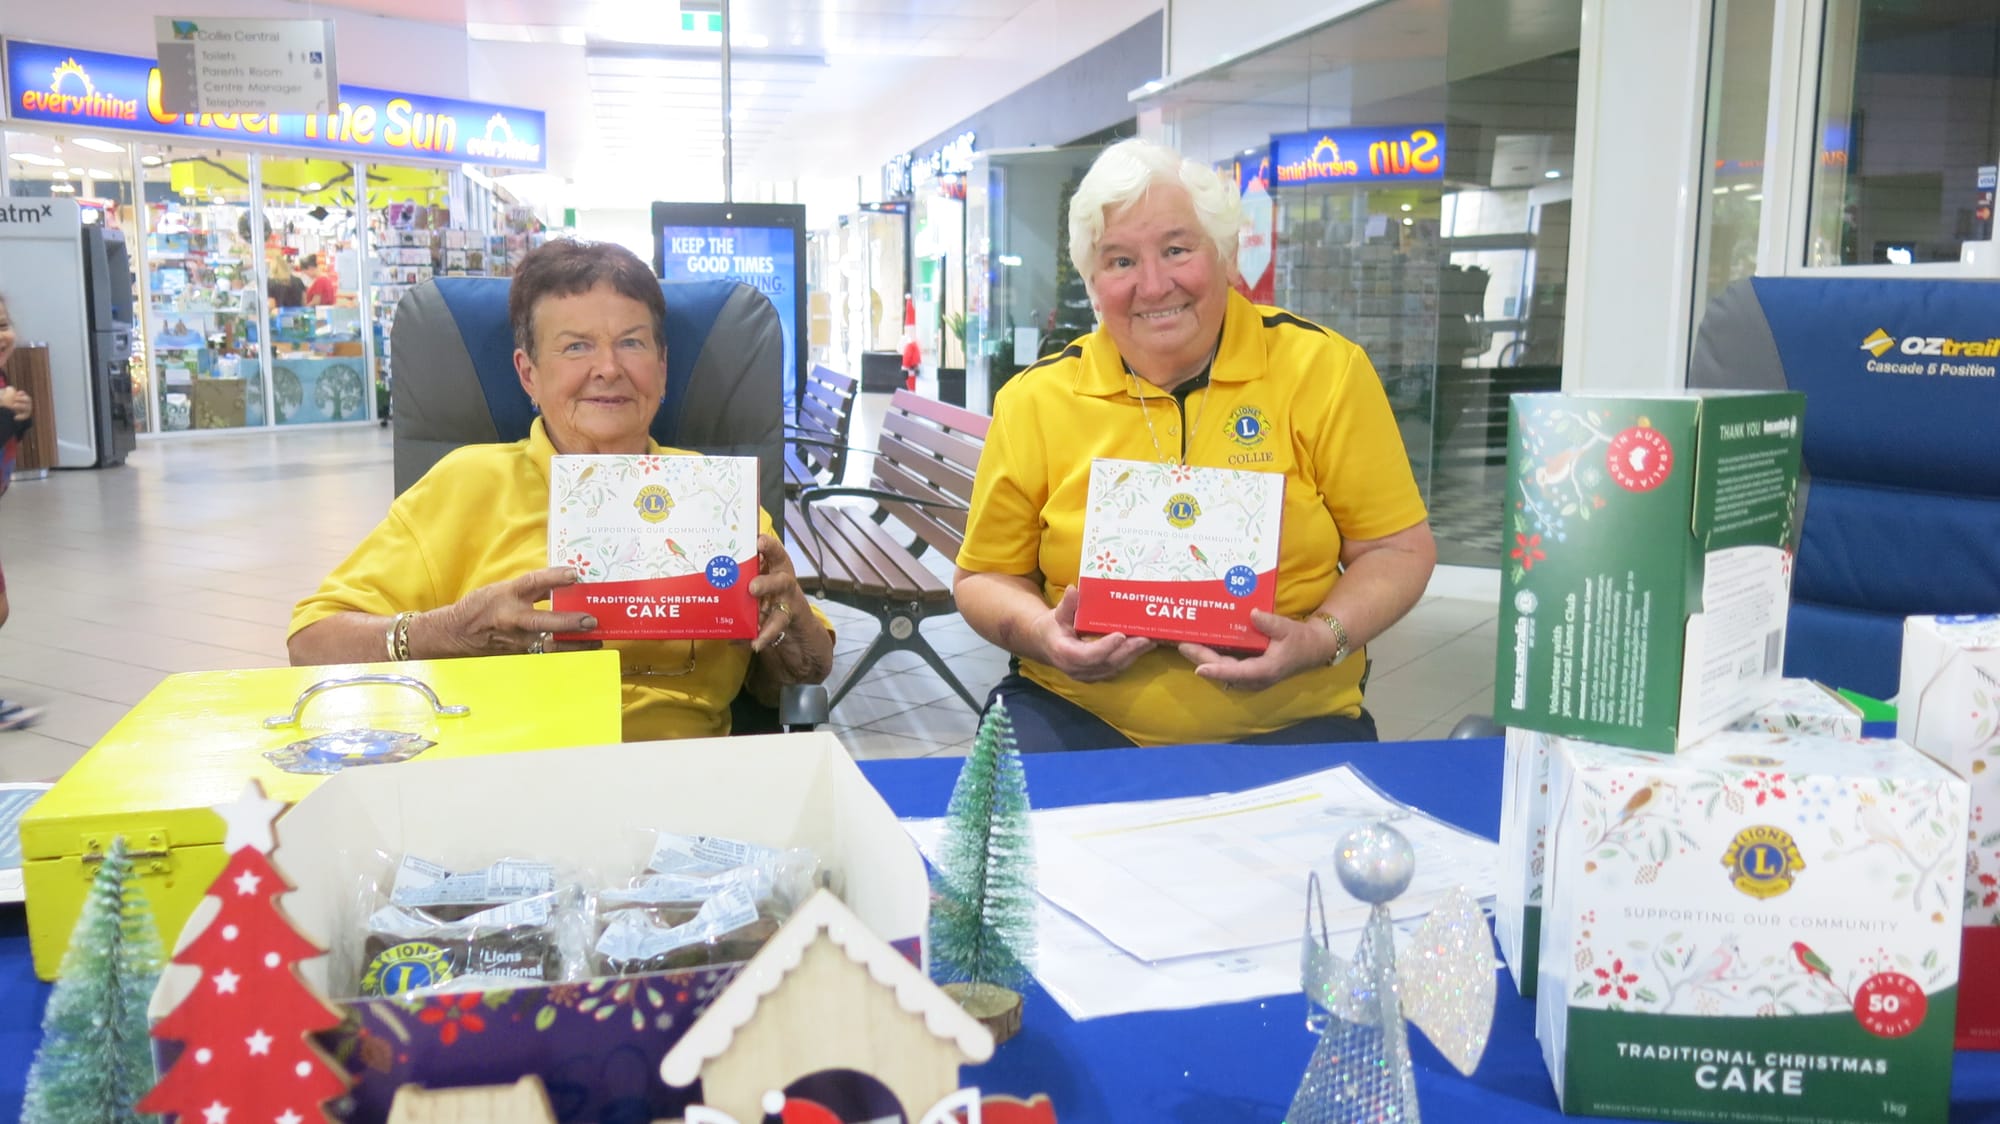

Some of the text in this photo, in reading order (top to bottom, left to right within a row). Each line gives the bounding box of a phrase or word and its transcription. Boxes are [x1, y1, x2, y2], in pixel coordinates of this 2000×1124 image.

[197, 29, 280, 42] Collie Central
[202, 51, 236, 61] Toilets
[203, 67, 283, 77] Parents Room
[203, 82, 302, 95] Centre Manager
[21, 90, 138, 121] everything
[206, 97, 267, 110] Telephone
[383, 98, 457, 153] Sun
[671, 236, 735, 255] KEEP THE
[687, 256, 775, 273] GOOD TIMES
[1866, 359, 1924, 375] Cascade
[1940, 363, 1995, 378] Position
[1720, 422, 1745, 440] THANK
[1745, 420, 1761, 438] YOU
[1228, 451, 1273, 465] COLLIE
[1635, 430, 1668, 488] AUSTRALIA
[668, 527, 721, 535] COMMUNITY
[586, 596, 720, 604] TRADITIONAL CHRISTMAS
[1110, 591, 1236, 611] TRADITIONAL CHRISTMAS
[626, 604, 681, 618] CAKE
[1145, 604, 1198, 620] CAKE
[715, 617, 734, 626] 1.5kg
[1229, 623, 1247, 632] 1.5kg
[1561, 592, 1576, 718] your local Lions Club
[1549, 625, 1563, 715] Volunteer with
[1738, 827, 1790, 846] LIONS
[1754, 847, 1776, 875] L
[1623, 906, 1899, 933] SUPPORTING OUR COMMUNITY
[484, 950, 522, 963] Lions
[1866, 976, 1916, 993] MIXED
[1866, 1016, 1911, 1036] FRUIT
[1616, 1042, 1888, 1075] TRADITIONAL CHRISTMAS
[1695, 1064, 1804, 1095] CAKE
